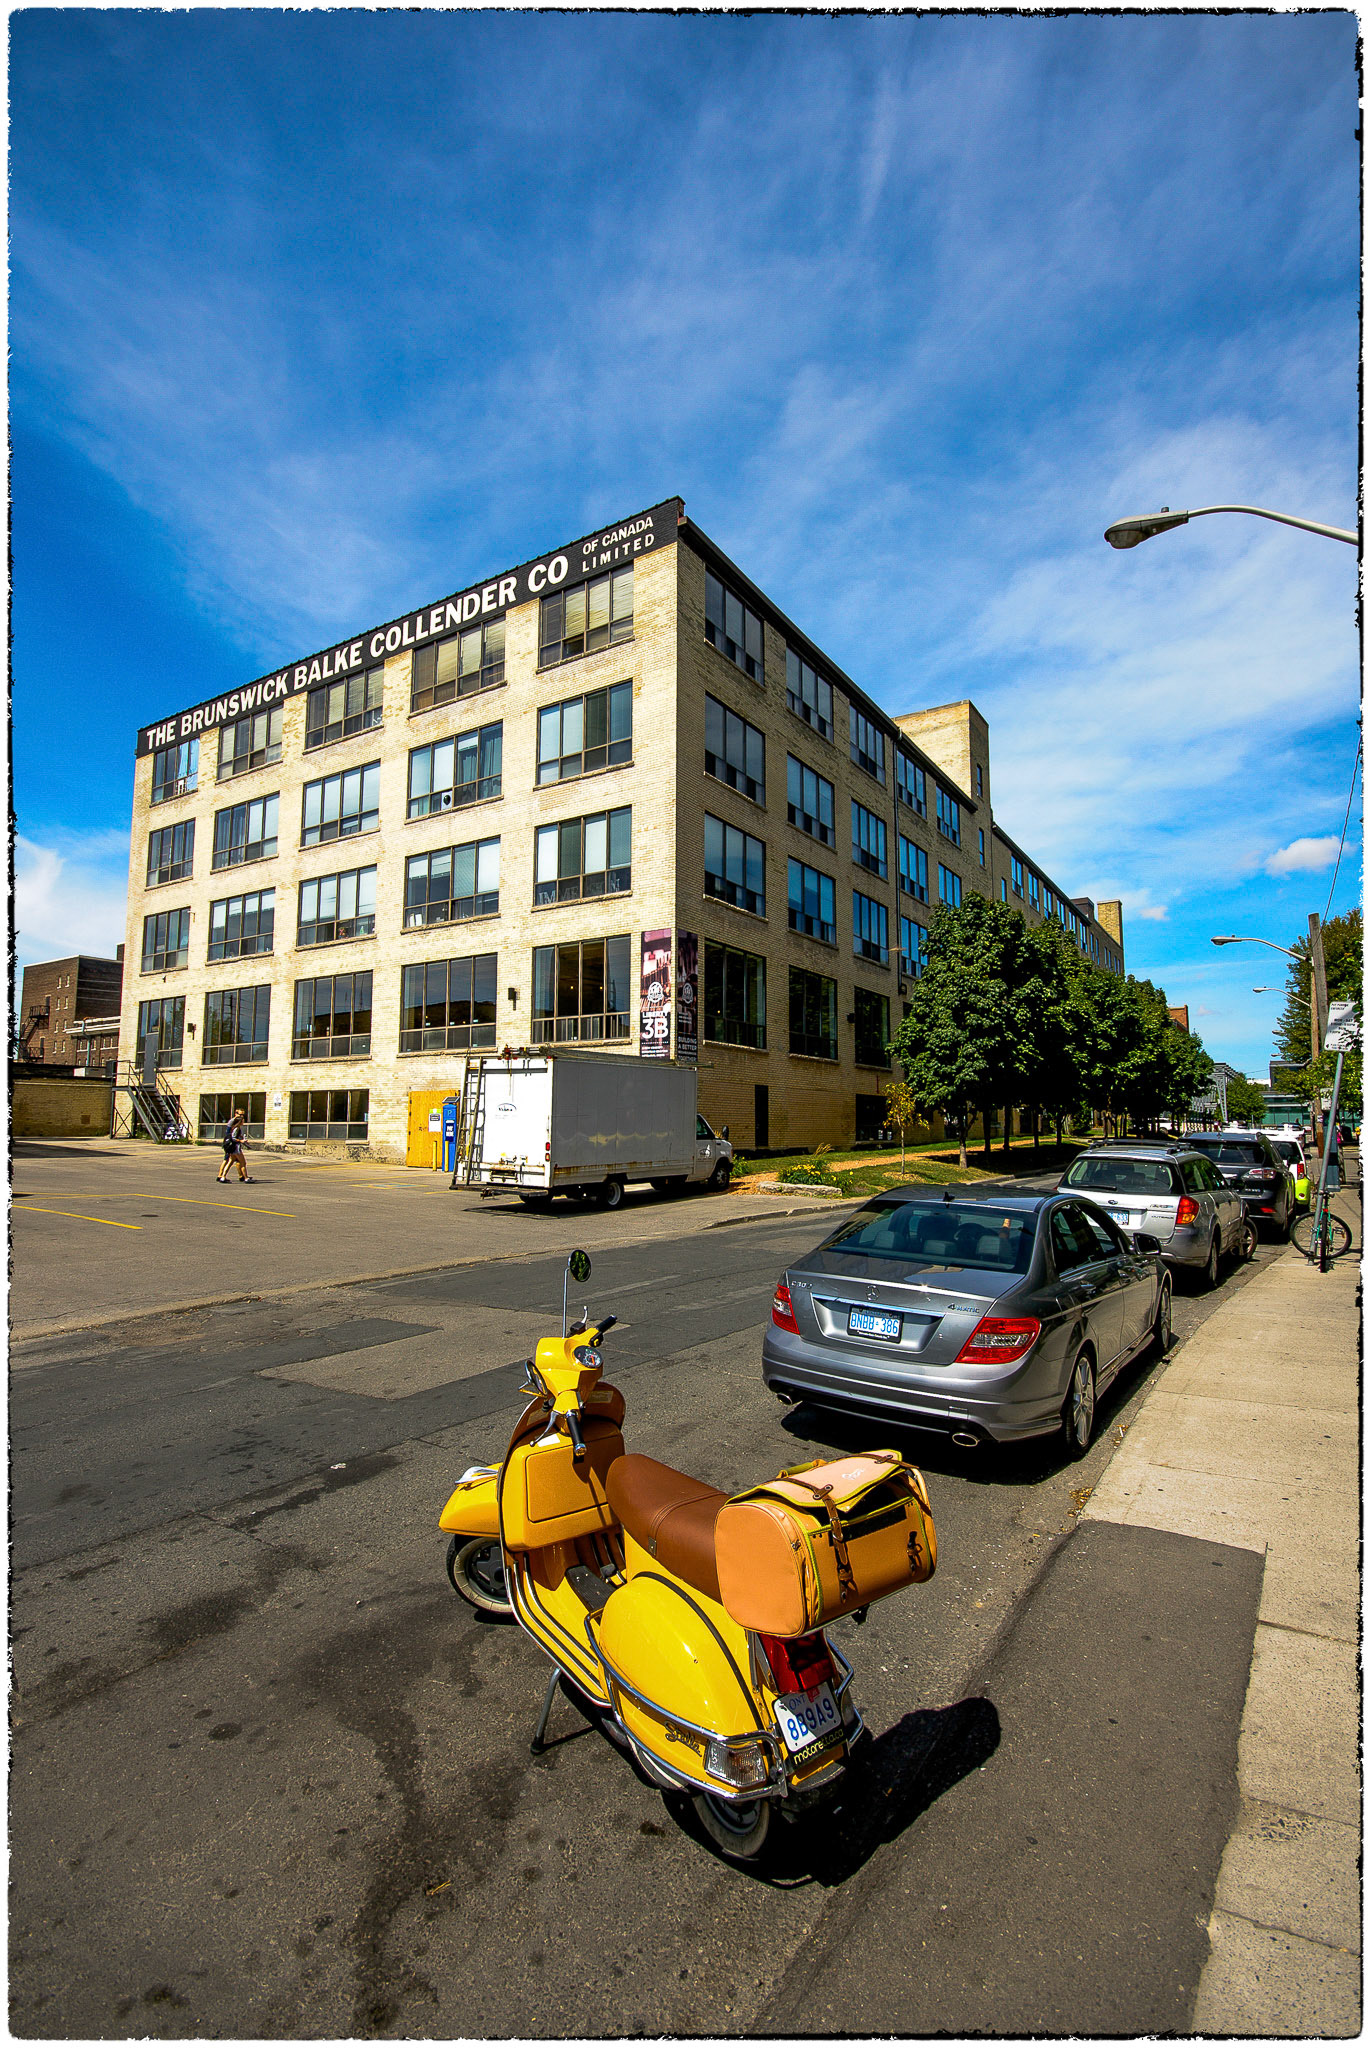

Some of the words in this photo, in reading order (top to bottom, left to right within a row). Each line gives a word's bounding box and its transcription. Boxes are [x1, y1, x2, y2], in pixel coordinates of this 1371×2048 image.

[582, 538, 599, 555] OF
[601, 515, 654, 548] CANADA
[582, 533, 656, 573] LIMITED
[146, 720, 177, 750] THE
[180, 672, 289, 738] BRUNSWICK
[293, 641, 363, 691] BALKE
[370, 576, 517, 659] COLLENDER
[527, 555, 569, 594] CO
[641, 1017, 669, 1039] 3B
[787, 1697, 834, 1741] 8B9A9
[788, 1694, 807, 1711] ONT
